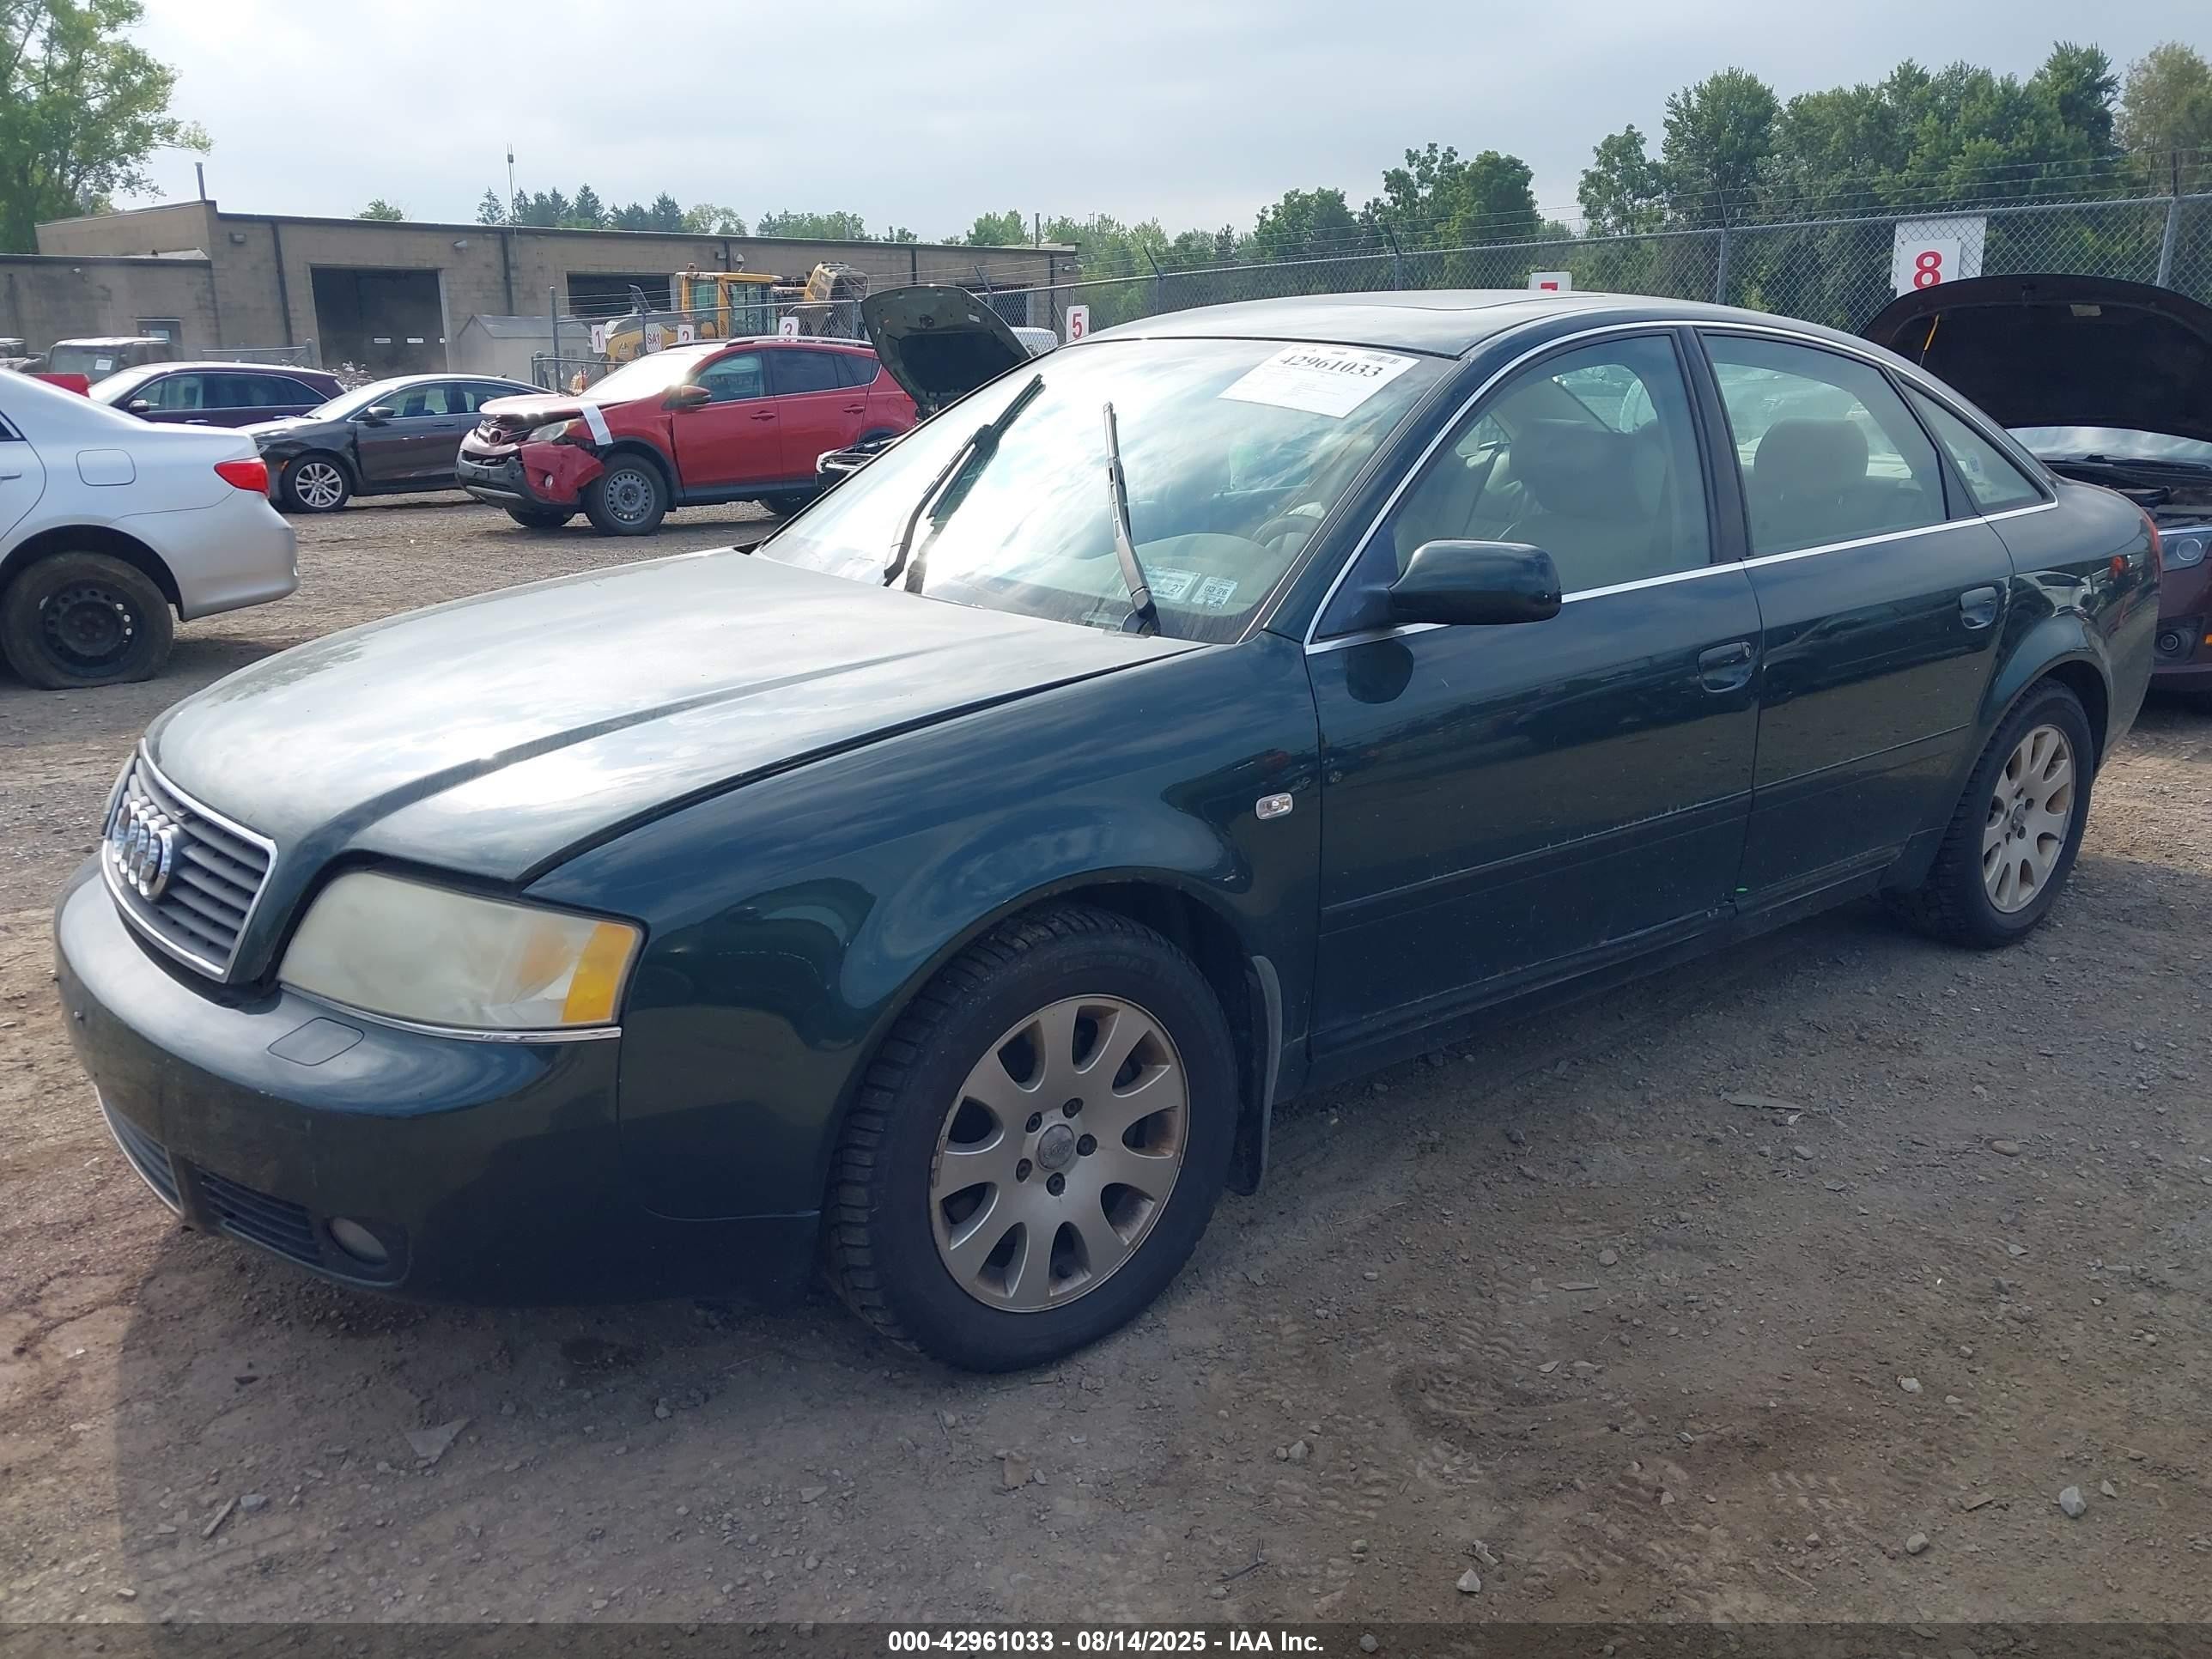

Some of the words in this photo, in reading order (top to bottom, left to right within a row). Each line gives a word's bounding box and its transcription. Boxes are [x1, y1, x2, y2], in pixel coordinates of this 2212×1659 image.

[1914, 251, 1942, 289] 8
[1073, 313, 1083, 339] 5
[595, 330, 601, 349] 1
[1279, 355, 1383, 377] 42961033
